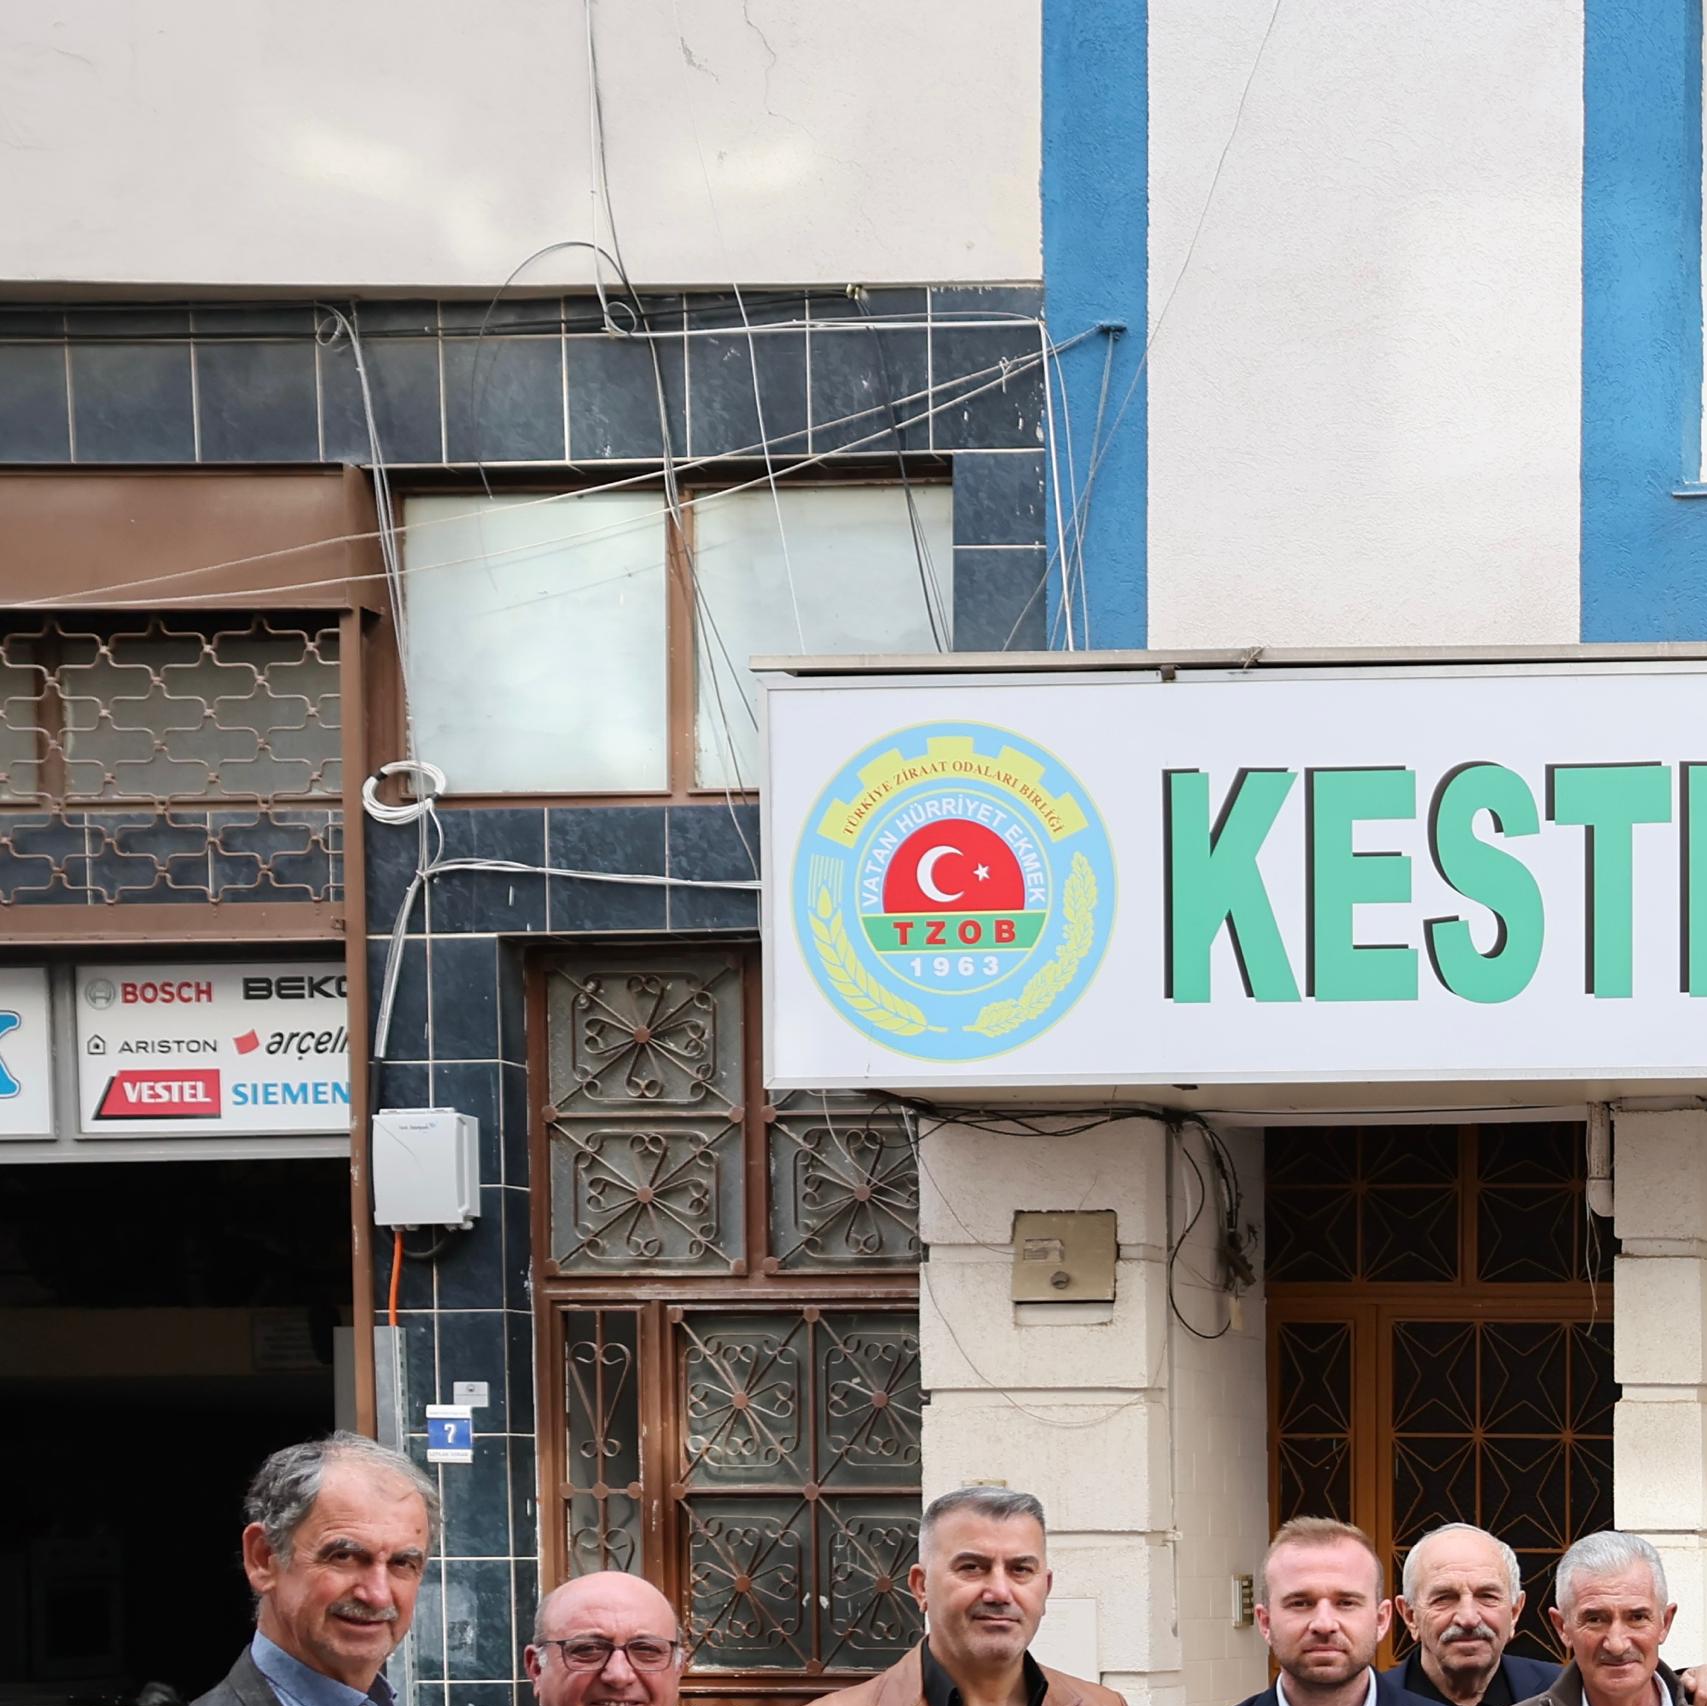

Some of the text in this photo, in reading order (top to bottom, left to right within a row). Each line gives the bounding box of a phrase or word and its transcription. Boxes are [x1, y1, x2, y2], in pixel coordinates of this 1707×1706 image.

[843, 760, 1065, 835] TÜRKİYE ZİRAAT ODALARI BİRLİĞİ
[861, 795, 1046, 907] VATAN HÜRRİYET EKMEK
[893, 920, 1017, 945] TZOB
[910, 956, 1000, 977] 1963
[121, 981, 213, 1004] BOSCH
[118, 1039, 218, 1055] ARISTON
[265, 1026, 349, 1061] arçeli
[123, 1081, 212, 1103] VESTEL
[232, 1081, 352, 1106] SIEMEN
[444, 1423, 456, 1444] 7
